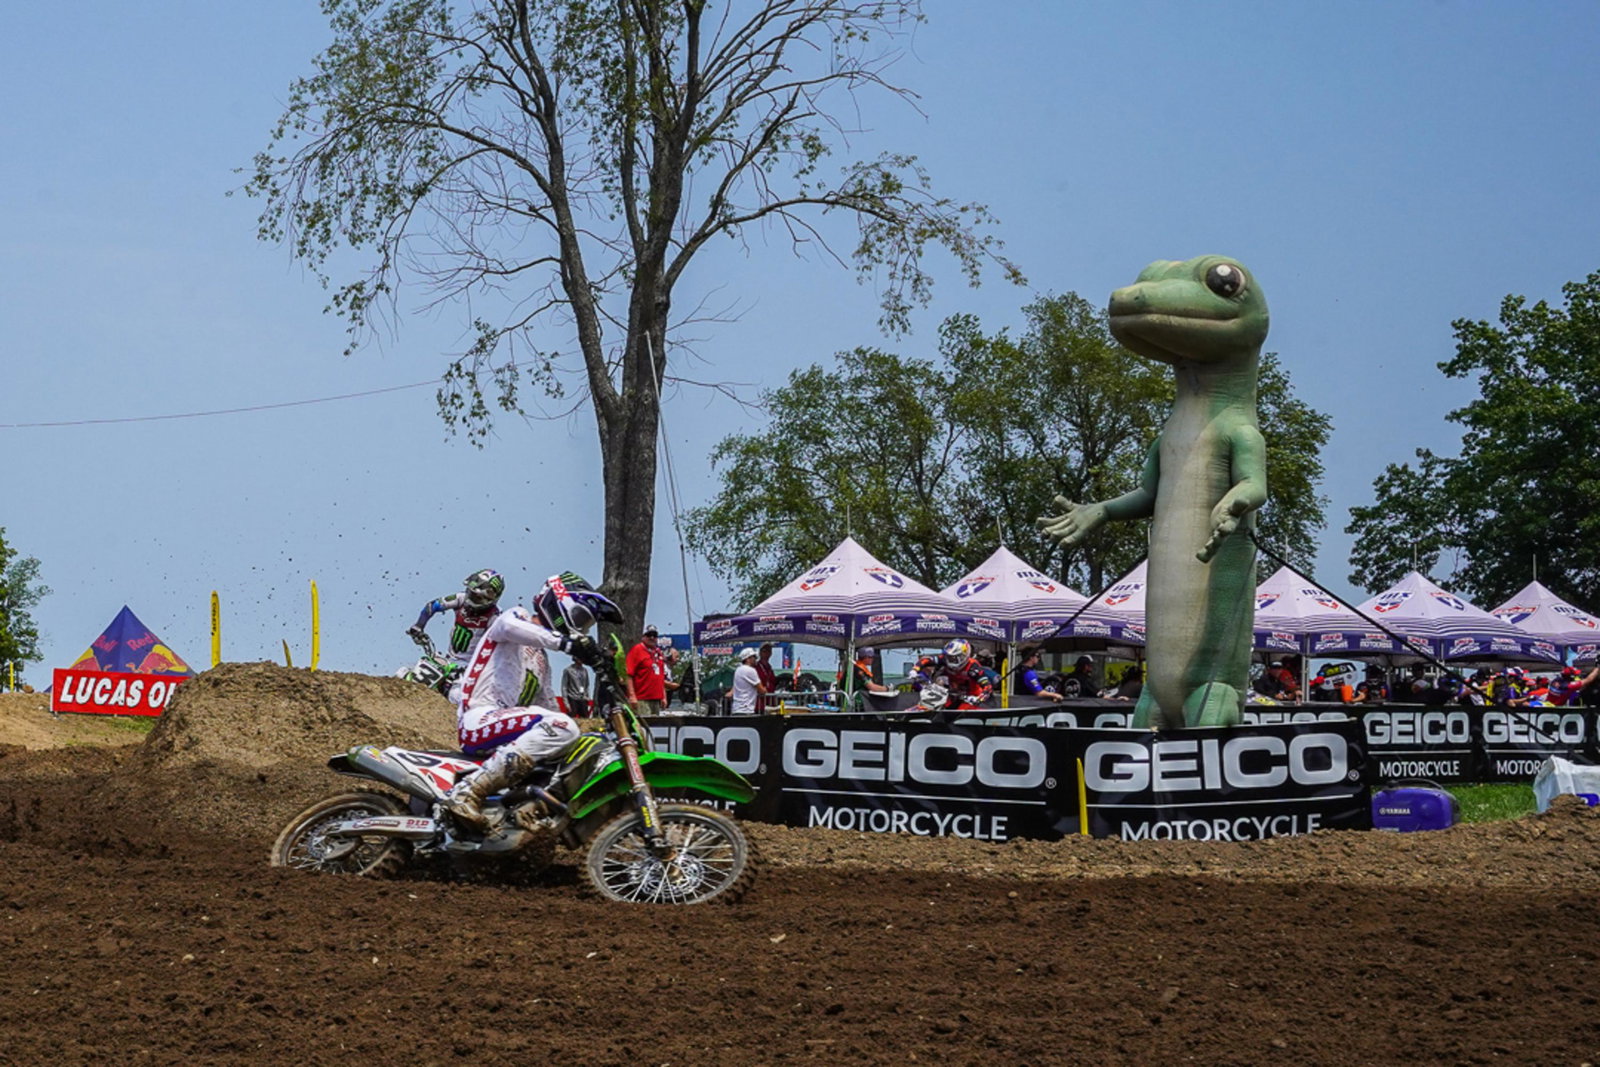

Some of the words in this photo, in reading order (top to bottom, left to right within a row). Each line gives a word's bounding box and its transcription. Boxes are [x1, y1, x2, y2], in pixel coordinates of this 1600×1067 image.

[60, 676, 144, 708] LUCAS
[148, 681, 176, 708] OI
[1363, 712, 1470, 744] GEICO
[1483, 712, 1585, 744] GEICO
[642, 725, 761, 775] EICO
[782, 728, 1047, 788] GEICO
[1084, 733, 1348, 792] GEICO
[1379, 760, 1460, 777] MOTORCYCLE
[1497, 759, 1547, 776] MOTOR
[808, 805, 1008, 840] MOTORCYCLE
